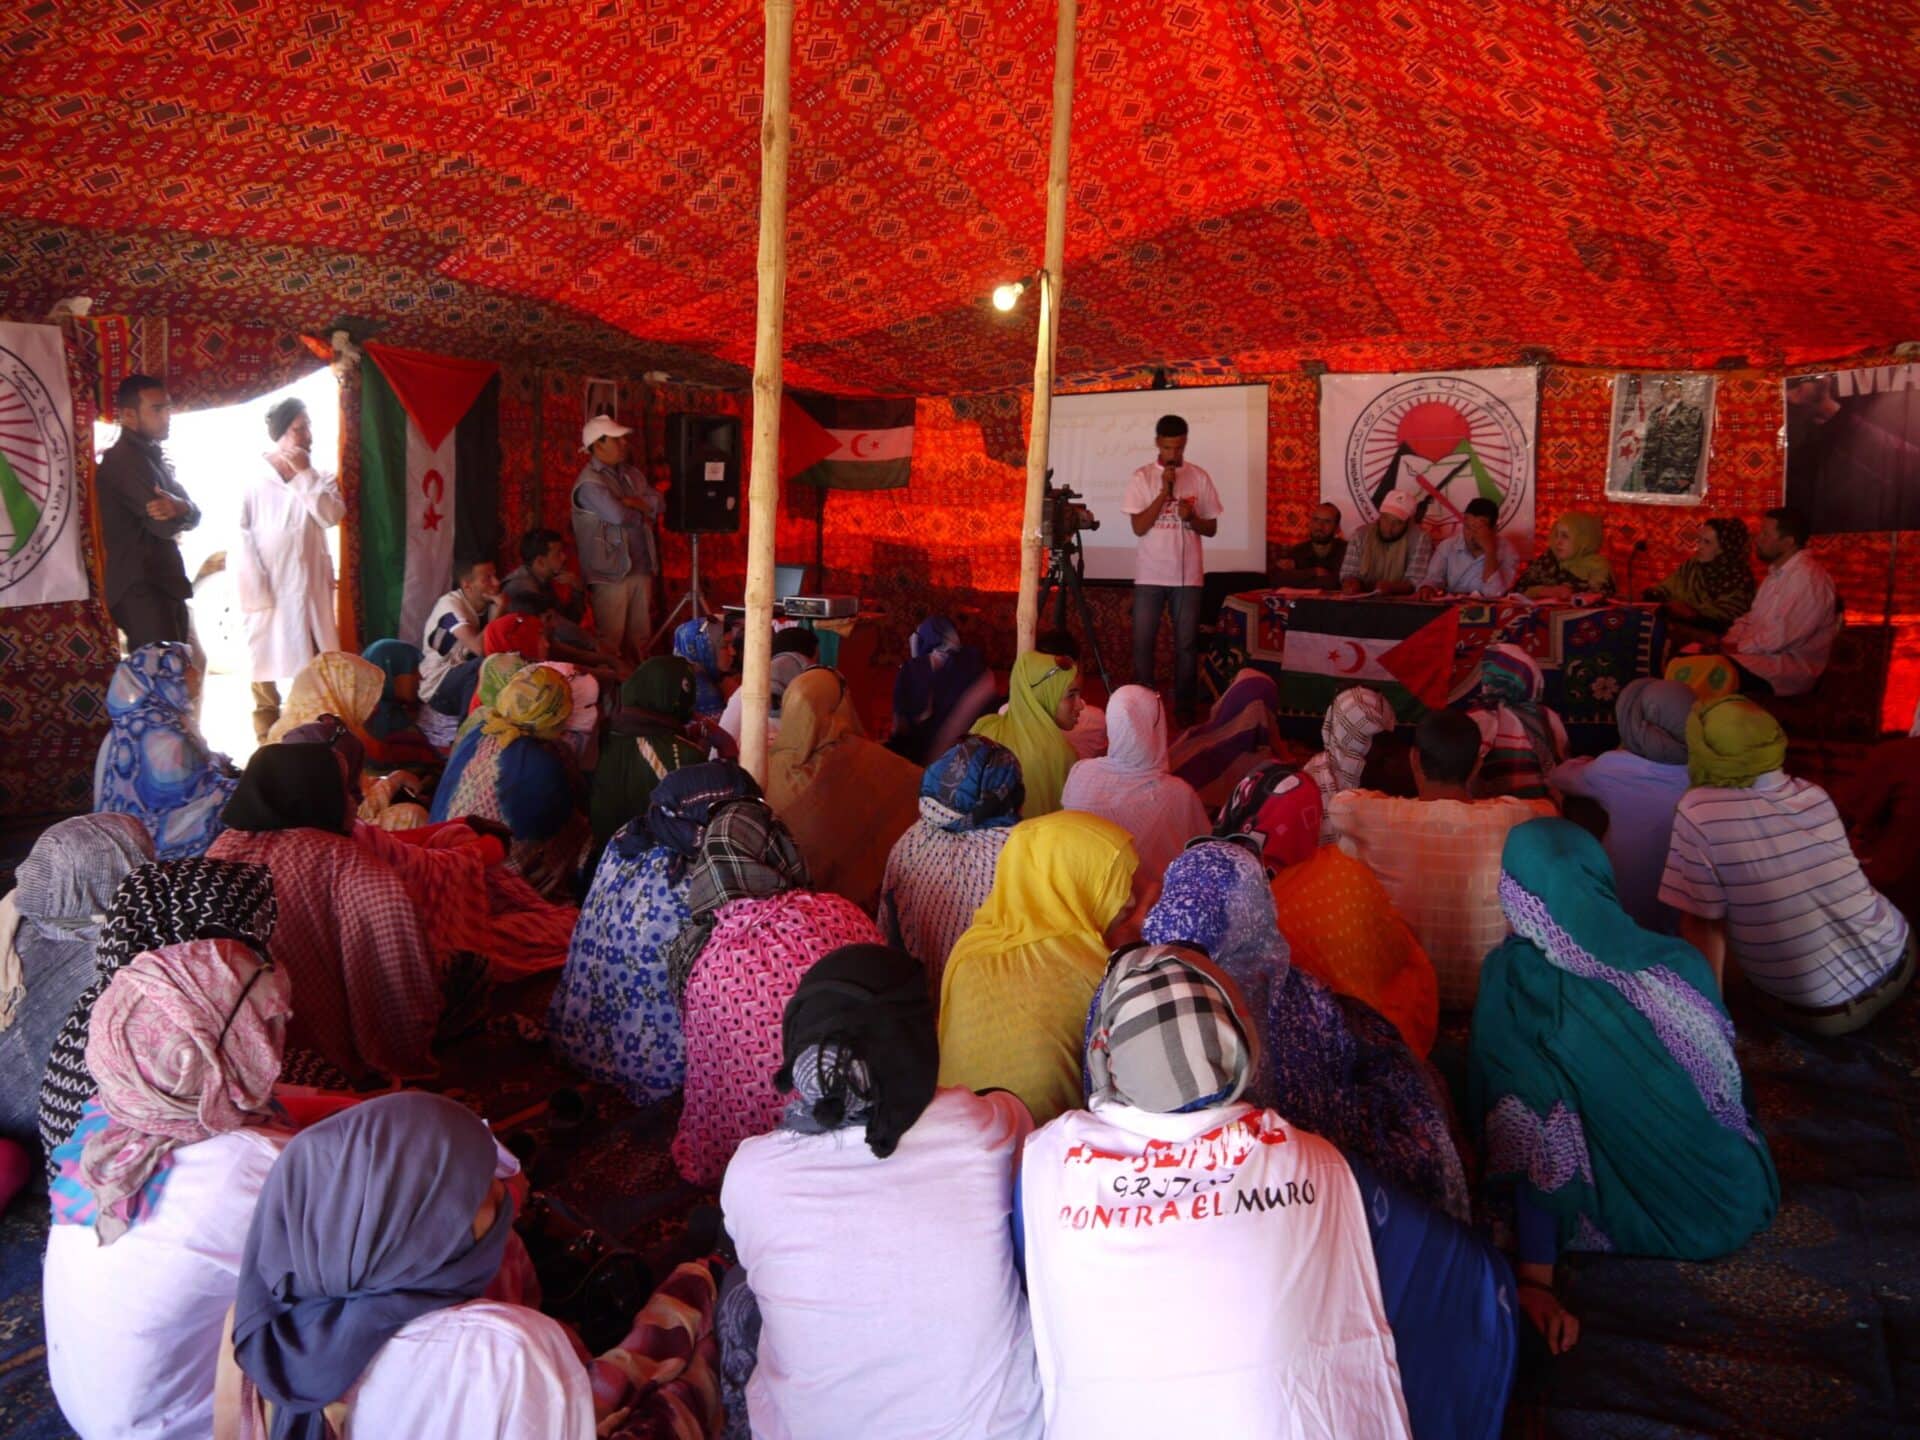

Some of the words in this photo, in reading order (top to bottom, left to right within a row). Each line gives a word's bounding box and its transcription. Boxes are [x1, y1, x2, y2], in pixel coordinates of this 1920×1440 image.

[1059, 1200, 1182, 1230] CONTRA
[1191, 1191, 1223, 1220] EL
[1234, 1178, 1315, 1214] MURO
